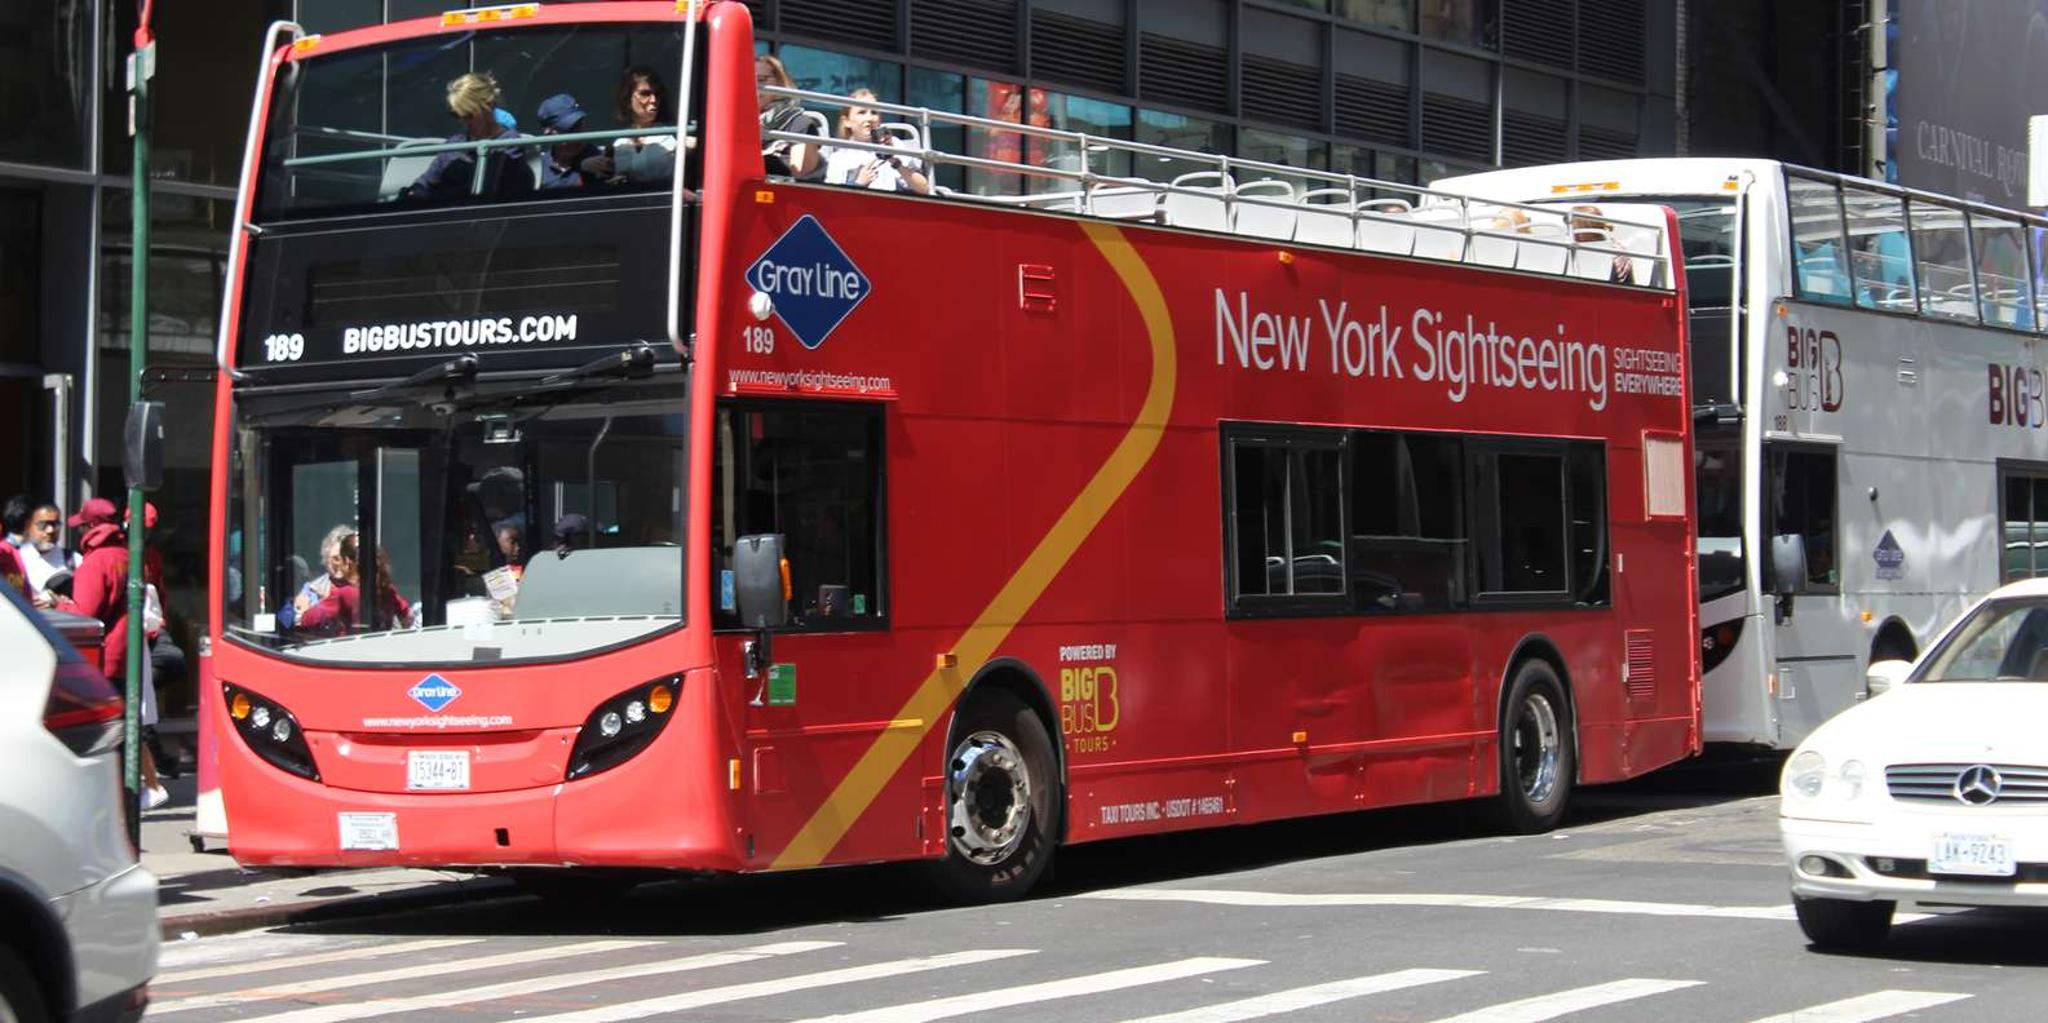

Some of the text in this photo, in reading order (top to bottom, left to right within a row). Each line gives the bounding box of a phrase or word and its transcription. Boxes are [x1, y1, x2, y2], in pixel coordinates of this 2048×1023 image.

[1917, 120, 1993, 178] CARNIVAL
[265, 333, 304, 362] 189
[343, 314, 577, 354] BIGBUSTOURS.COM
[743, 326, 774, 354] 189
[1787, 326, 1818, 369] BIG
[1215, 288, 1607, 411] New York Sightseeing
[1614, 347, 1682, 373] SIGHTSEEING
[729, 368, 890, 390] www.newyorksightseeing.com
[1615, 373, 1682, 396] EVERYWHERE
[1060, 644, 1117, 661] POWERED BY
[1061, 667, 1093, 702] BIG
[363, 716, 512, 729] www.newyorksightseeing.com
[1062, 702, 1094, 735] BUS
[1074, 738, 1109, 753] TOURS
[1101, 806, 1119, 824] TAXI
[1119, 803, 1145, 822] TOURS
[1166, 799, 1191, 818] USDOT
